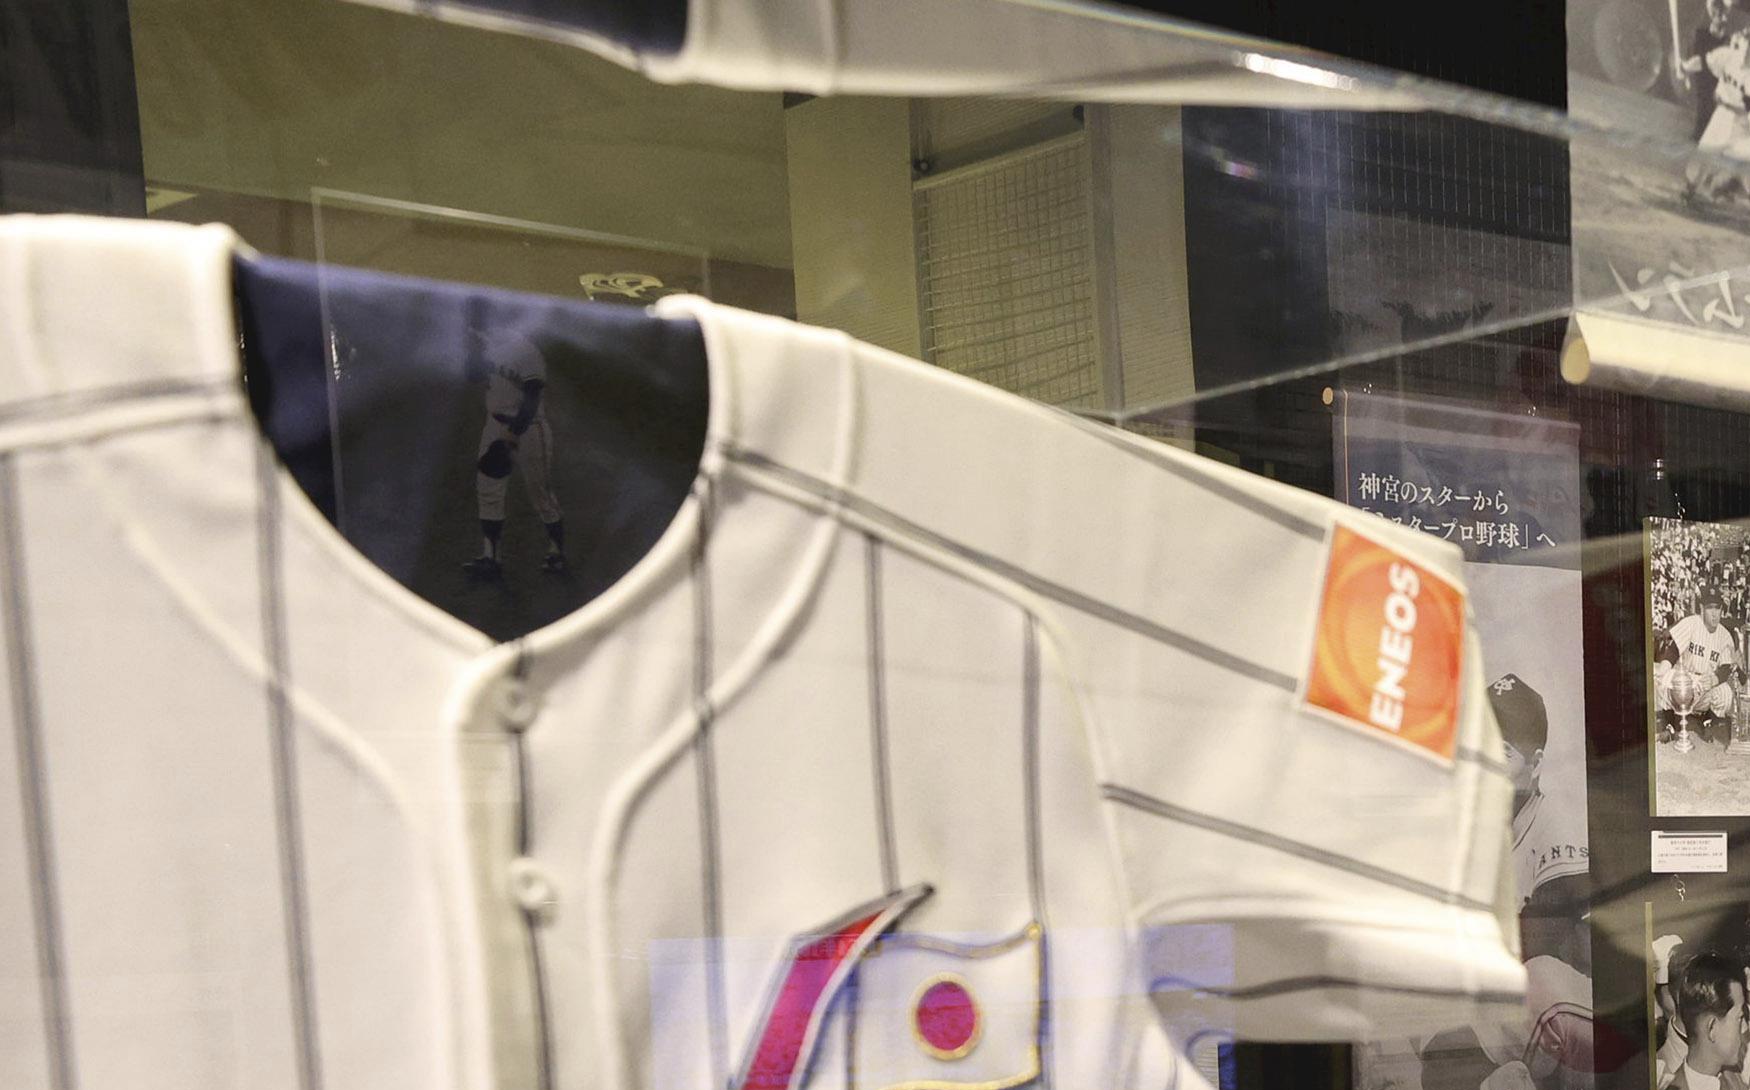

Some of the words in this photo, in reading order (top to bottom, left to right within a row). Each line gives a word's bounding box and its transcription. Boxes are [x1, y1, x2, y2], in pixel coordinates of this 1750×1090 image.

[1358, 471, 1510, 515] 神宮のスターから
[1361, 505, 1557, 550] 「スタープロ野球」へ
[1368, 560, 1423, 732] ENEOS
